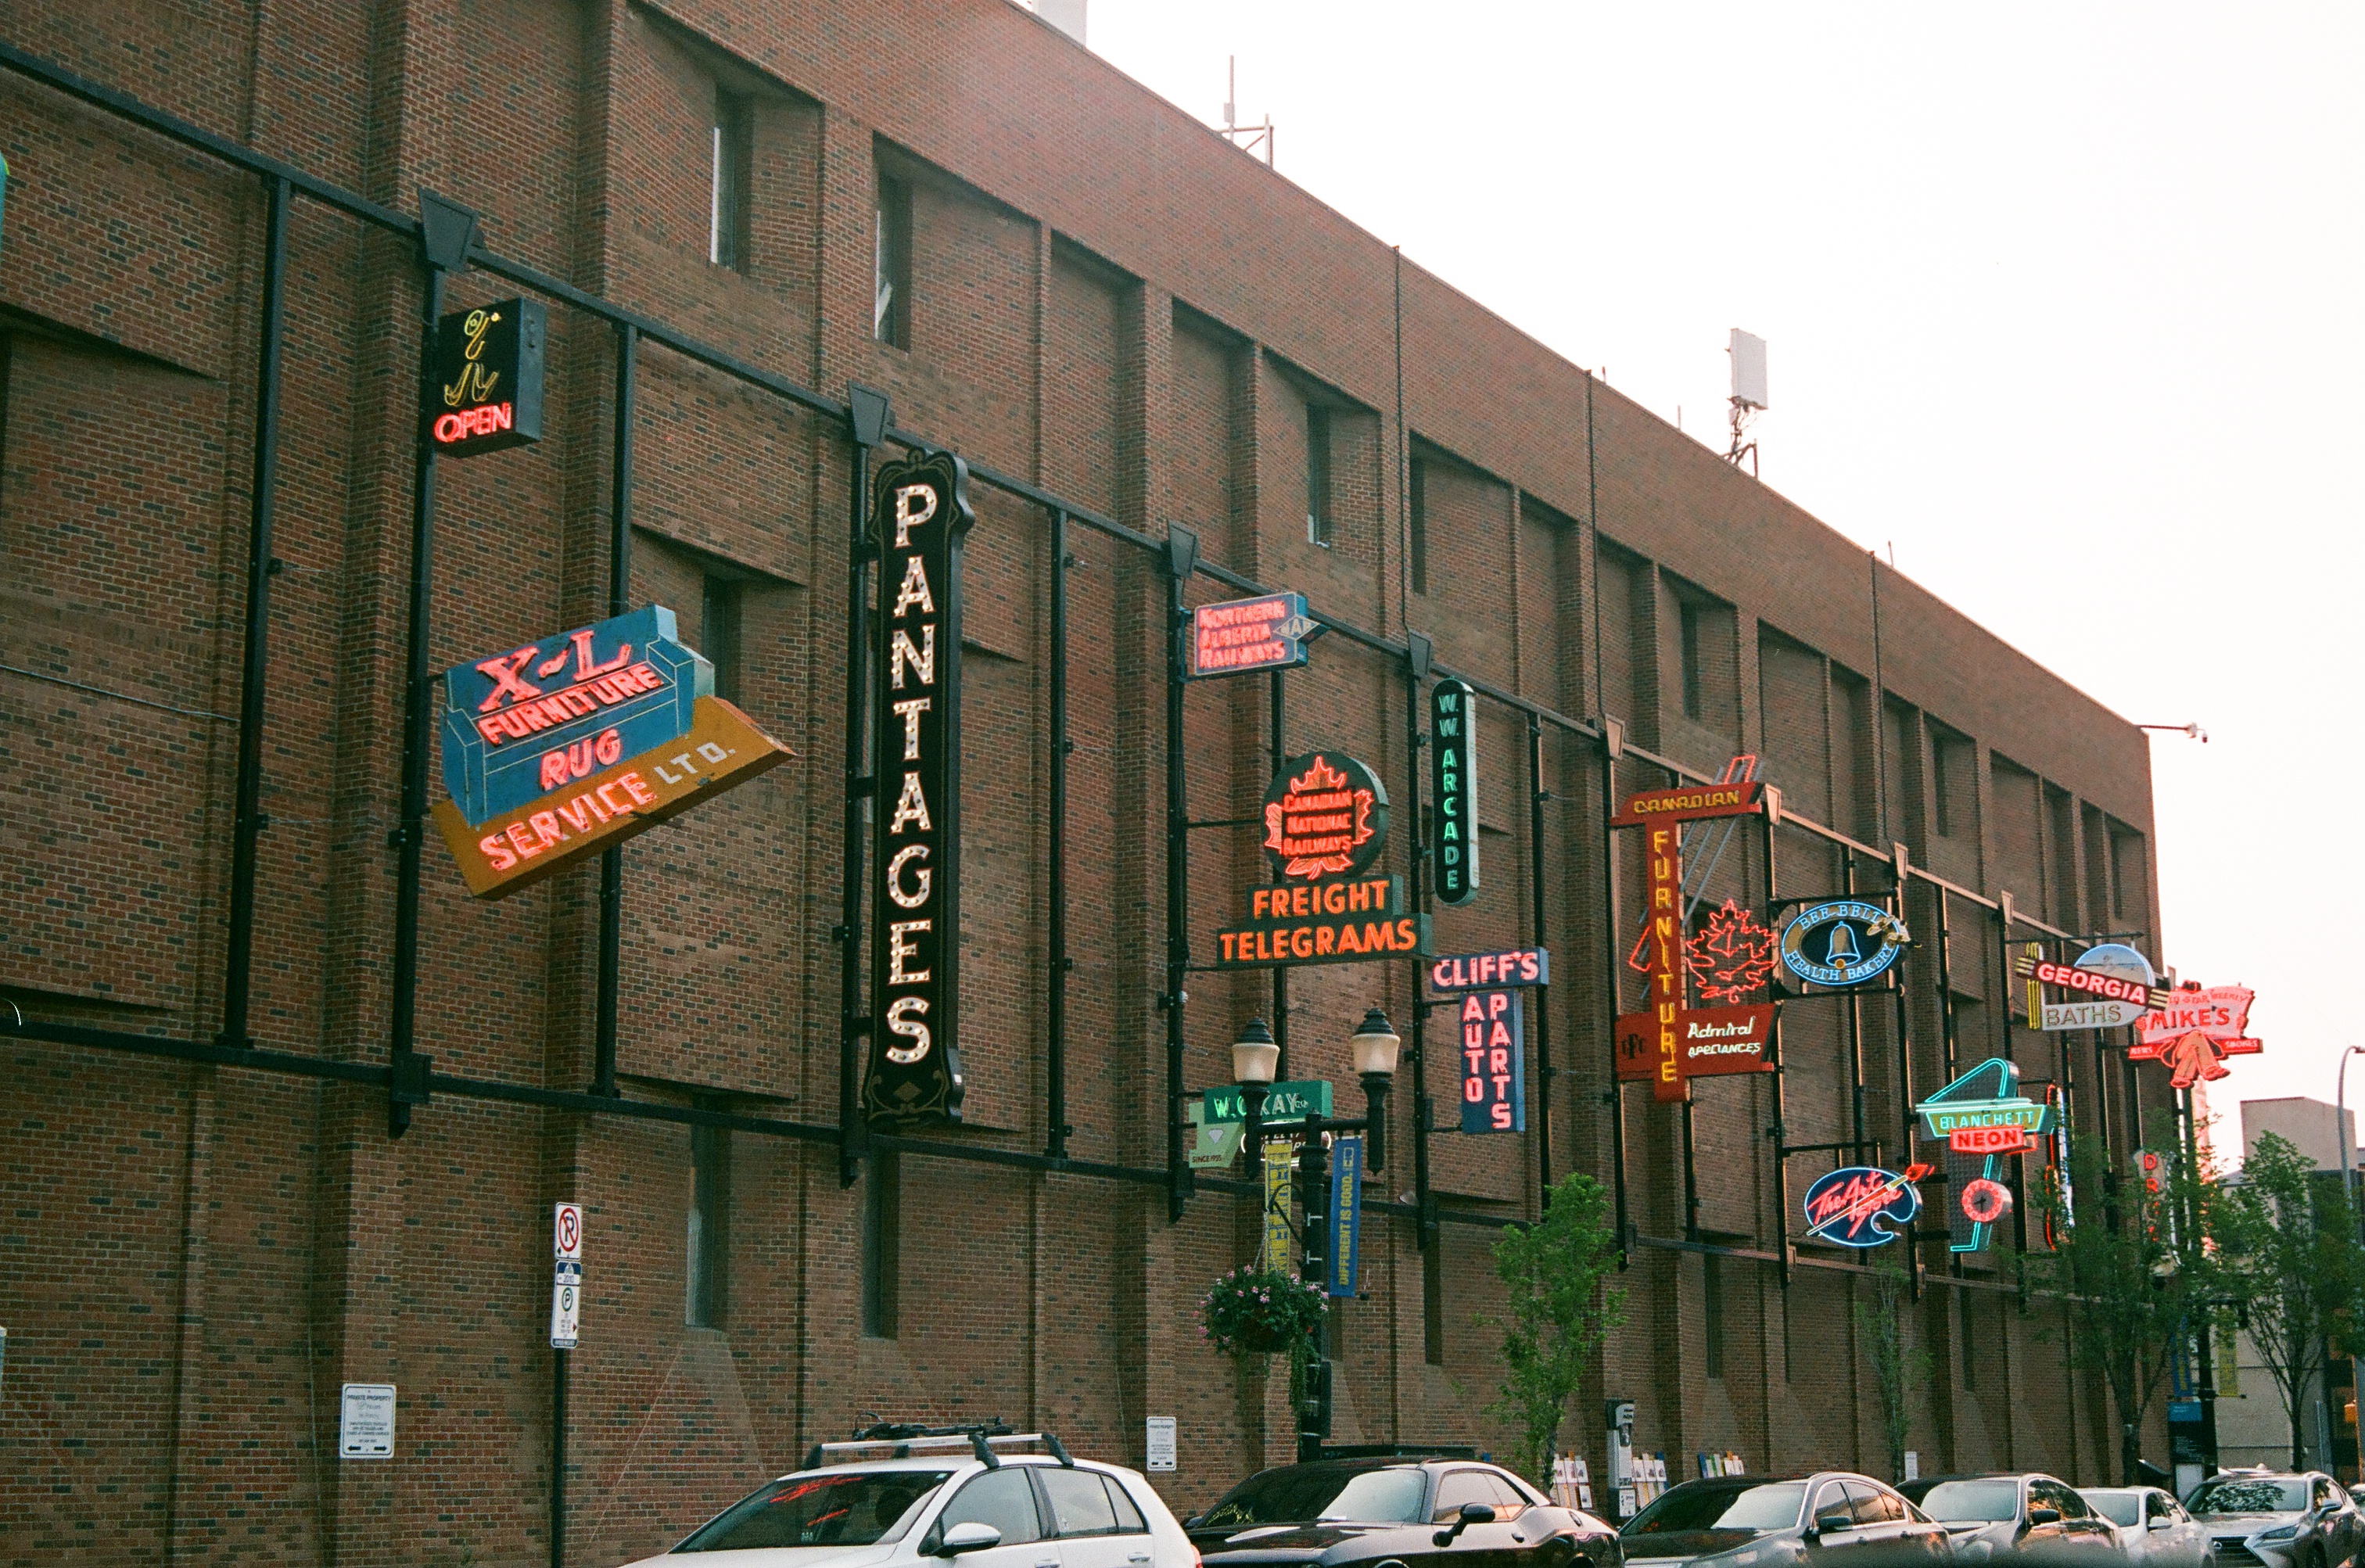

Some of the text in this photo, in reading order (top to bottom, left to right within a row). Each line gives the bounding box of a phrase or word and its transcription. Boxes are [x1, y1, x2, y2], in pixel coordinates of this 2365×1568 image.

[434, 401, 512, 443] OPEN
[476, 629, 633, 712] X-L
[1199, 640, 1287, 669] RAILWAYS
[477, 664, 665, 745] FURNITURE
[540, 728, 623, 791] RUG
[885, 483, 938, 1064] PANTAGES
[479, 741, 737, 871] SERVICE LTD.
[1282, 789, 1353, 813] CANADIAN
[1442, 748, 1459, 890] ARCADE
[1634, 790, 1740, 814] CANADIAN
[1283, 835, 1353, 856] RAILWAYS
[1253, 879, 1390, 920] FREIGHT
[1219, 918, 1417, 962] TELEGRAMS
[1653, 831, 1678, 1082] FURNITURE
[1432, 950, 1539, 988] CLIFF'S
[1786, 942, 1894, 981] HEALTH BAKERY
[2037, 963, 2148, 1006] GEORGIA
[1688, 1016, 1756, 1039] Admiral
[2045, 1003, 2123, 1027] BATHS
[2149, 1006, 2229, 1031] MIKE'S
[1462, 993, 1485, 1103] AUTO
[1489, 993, 1512, 1128] PARTS
[2130, 1046, 2152, 1055] NEWS
[1940, 1110, 2034, 1130] BLANCHETT
[1957, 1128, 2019, 1148] NEON
[1192, 1155, 1210, 1164] SINCE
[1340, 1208, 1351, 1222] IS
[1807, 1181, 1846, 1225] The
[1338, 1223, 1351, 1286] DIFFERENT
